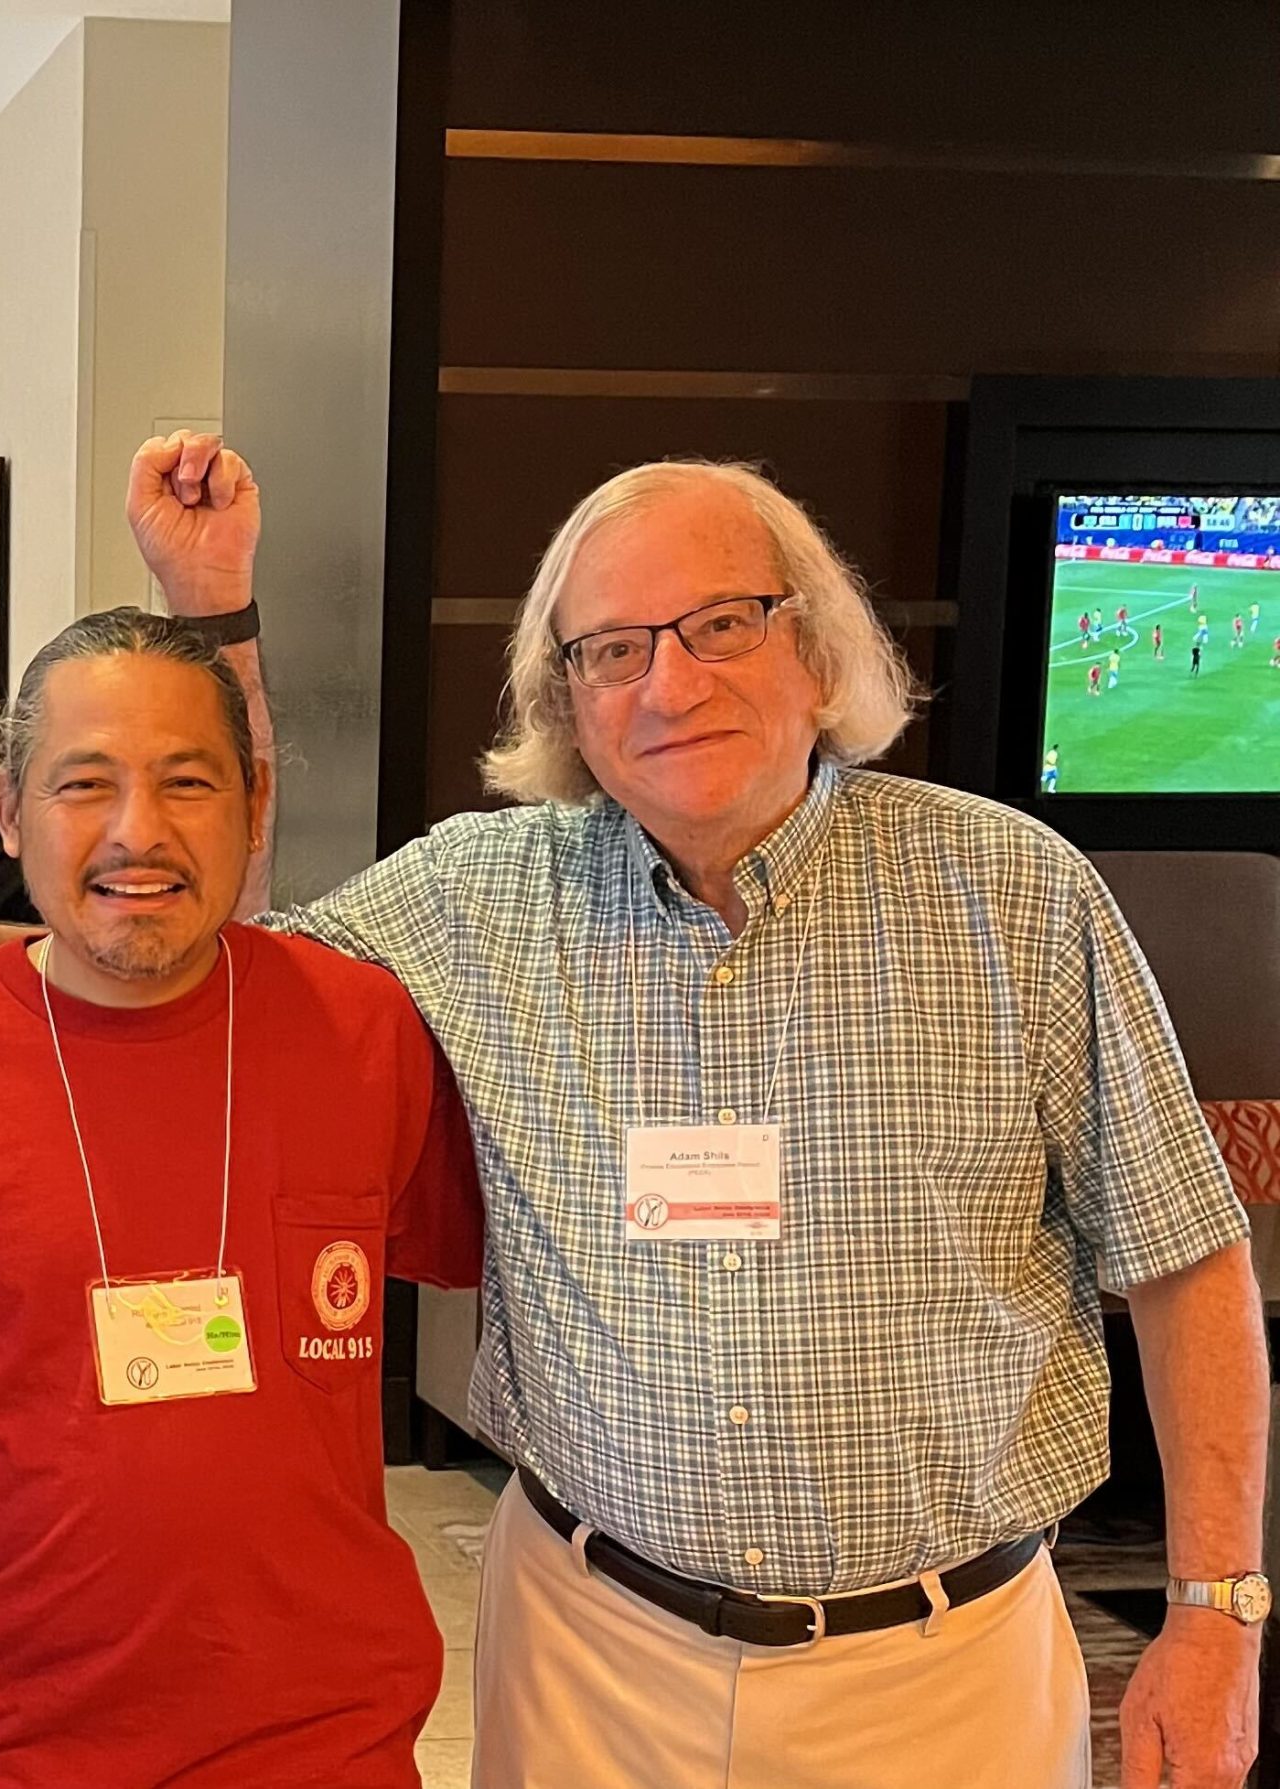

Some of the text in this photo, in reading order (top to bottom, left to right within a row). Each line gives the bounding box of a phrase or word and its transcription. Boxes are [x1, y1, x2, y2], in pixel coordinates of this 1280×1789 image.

[669, 1151, 701, 1161] Adam
[298, 1336, 373, 1360] LOCAL 915
